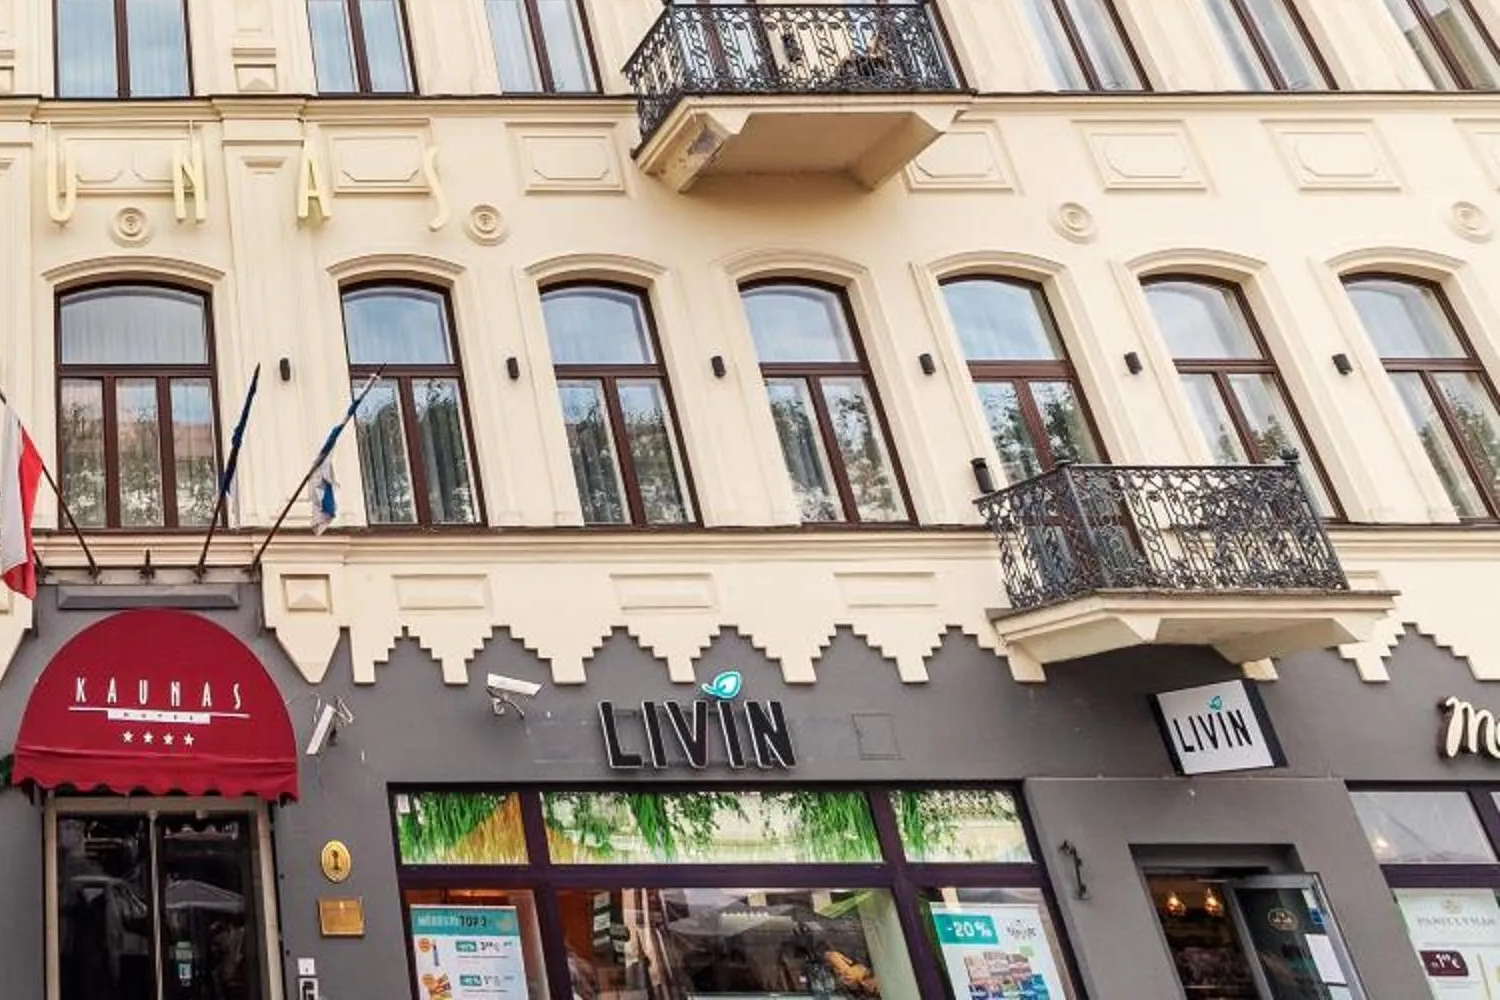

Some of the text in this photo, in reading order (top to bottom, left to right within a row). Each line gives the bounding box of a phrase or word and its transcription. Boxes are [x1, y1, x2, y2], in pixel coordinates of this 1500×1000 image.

[74, 676, 242, 711] KAUNAS
[598, 700, 797, 769] LIVIN
[1173, 709, 1253, 753] LIVIN
[946, 920, 993, 938] -20%
